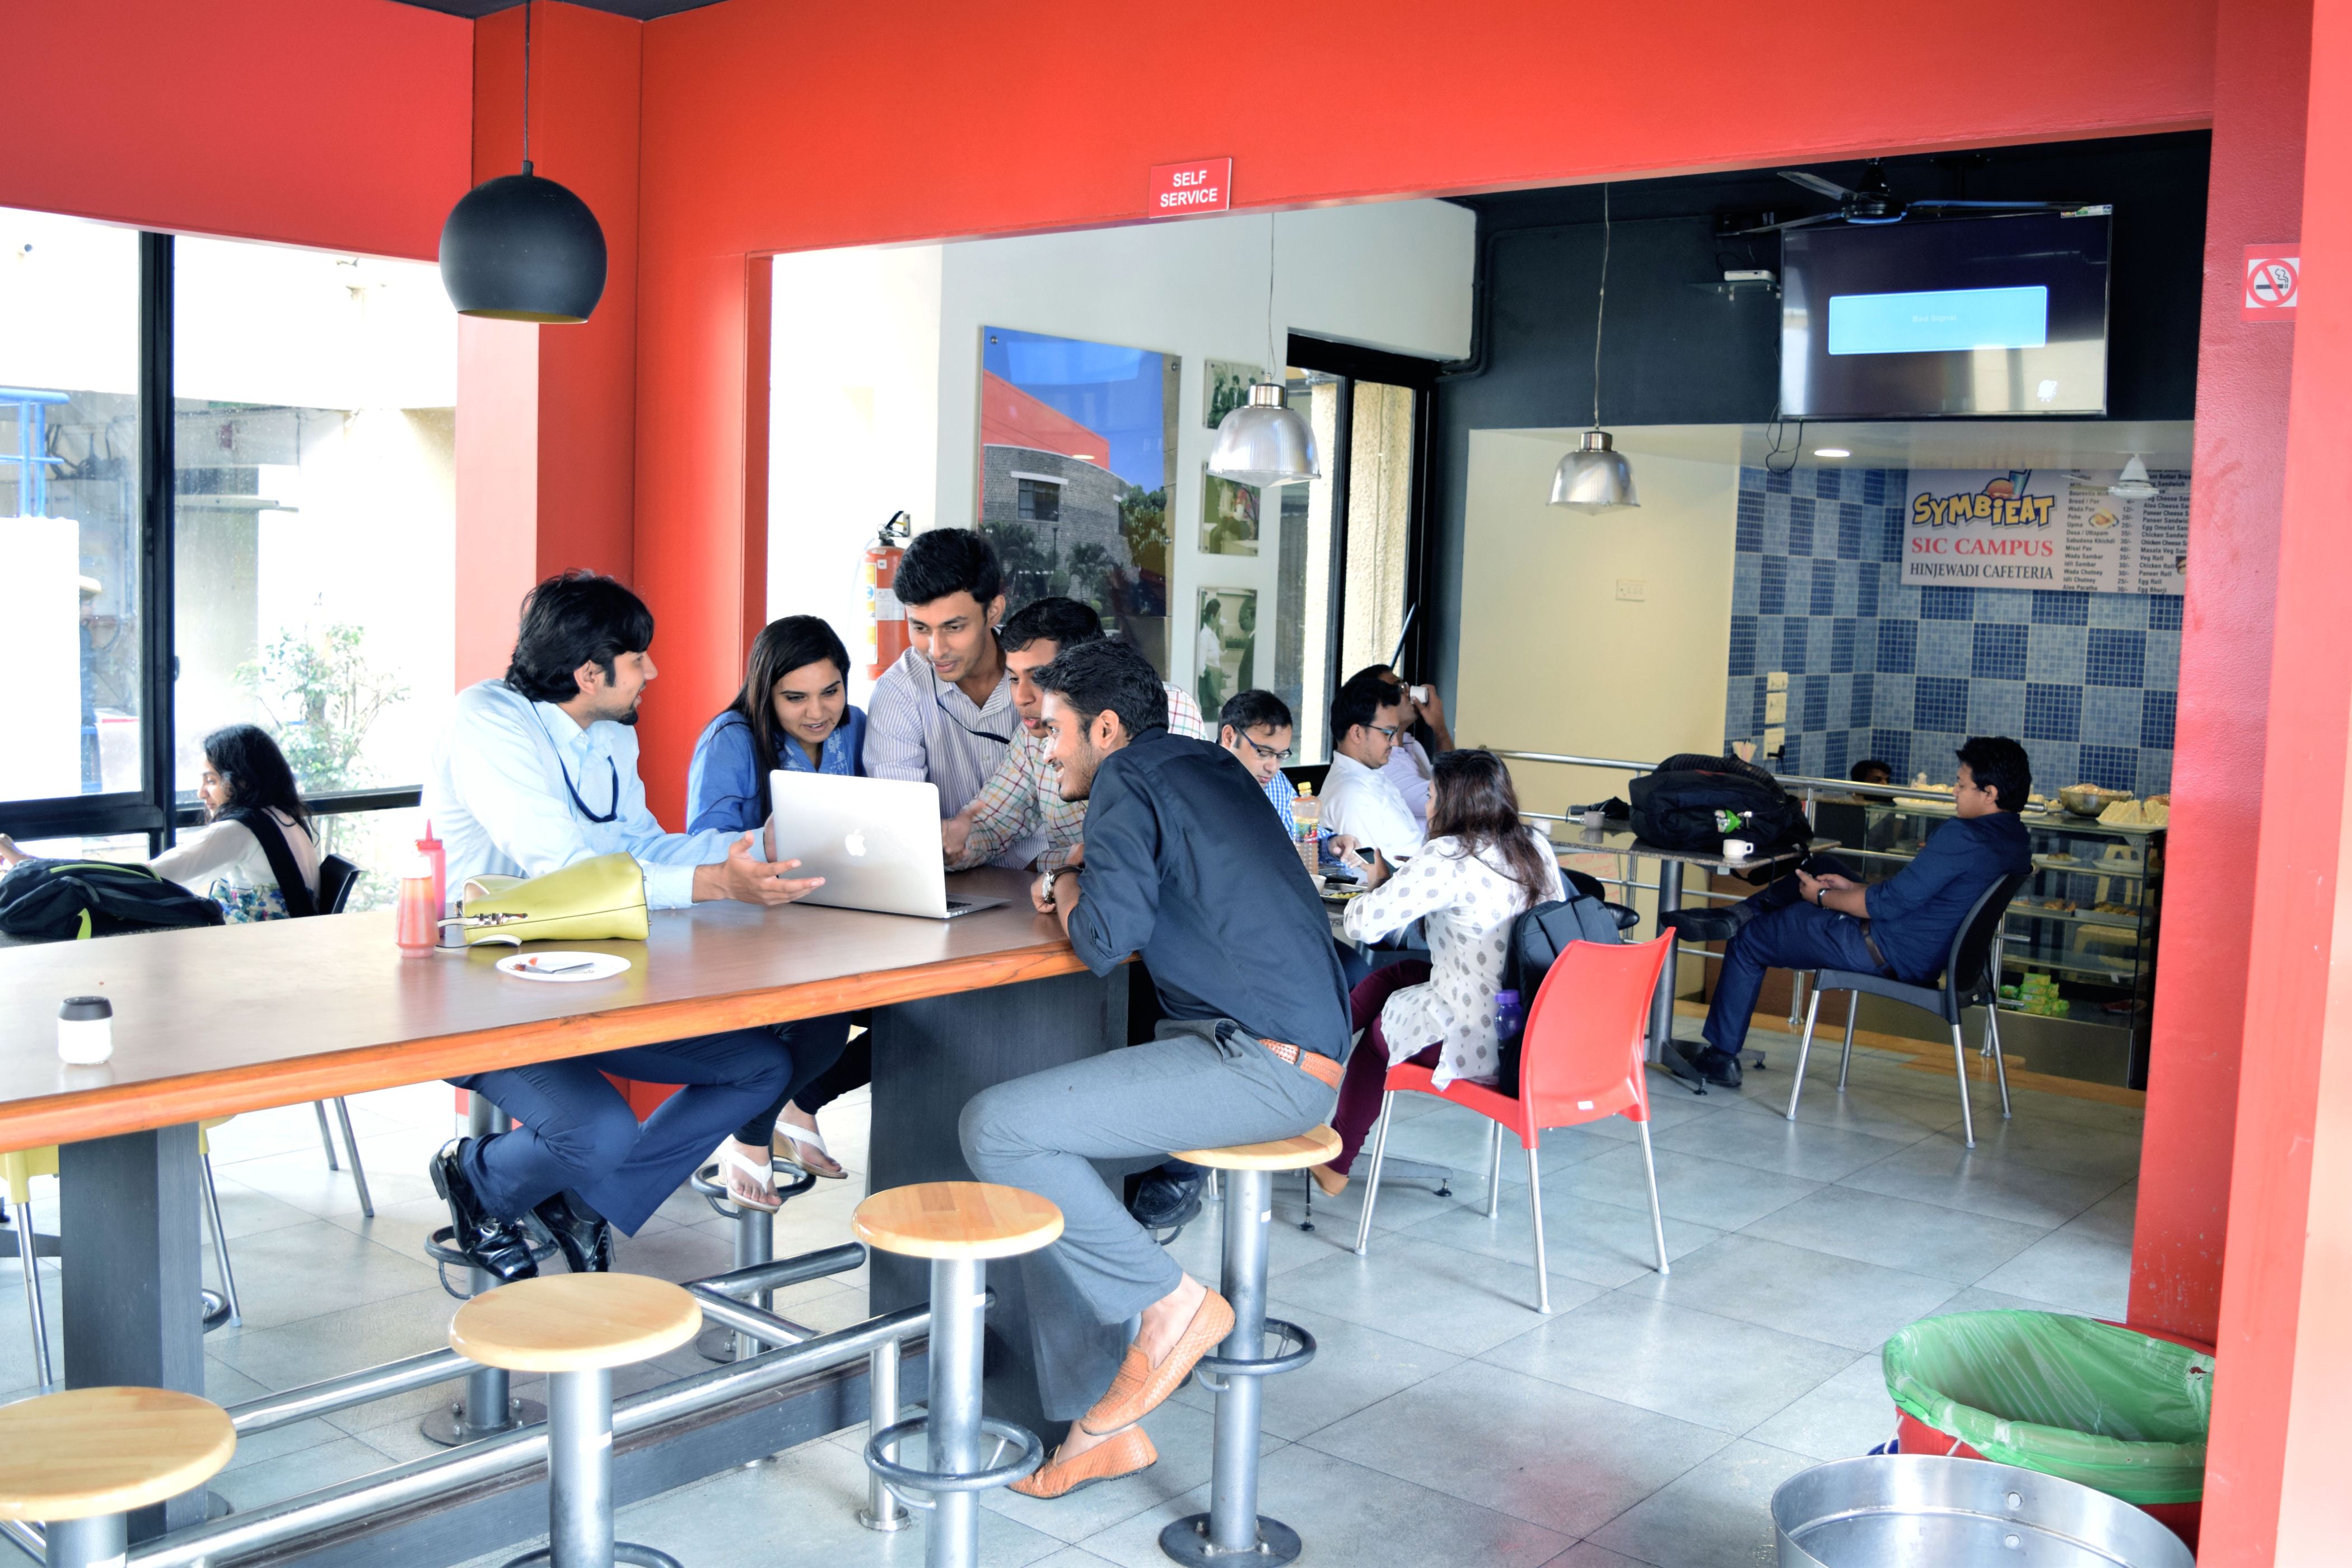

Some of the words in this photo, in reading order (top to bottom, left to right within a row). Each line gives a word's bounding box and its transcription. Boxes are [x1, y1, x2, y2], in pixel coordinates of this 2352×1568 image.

[1173, 170, 1207, 187] SELF
[1160, 188, 1218, 207] SERVICE
[1930, 314, 1957, 323] Signal
[1911, 537, 1947, 554] SIC
[1954, 538, 2054, 557] CAMPUS
[1910, 562, 1979, 578] HINJEWADI
[1983, 564, 2054, 580] CAFETERIA
